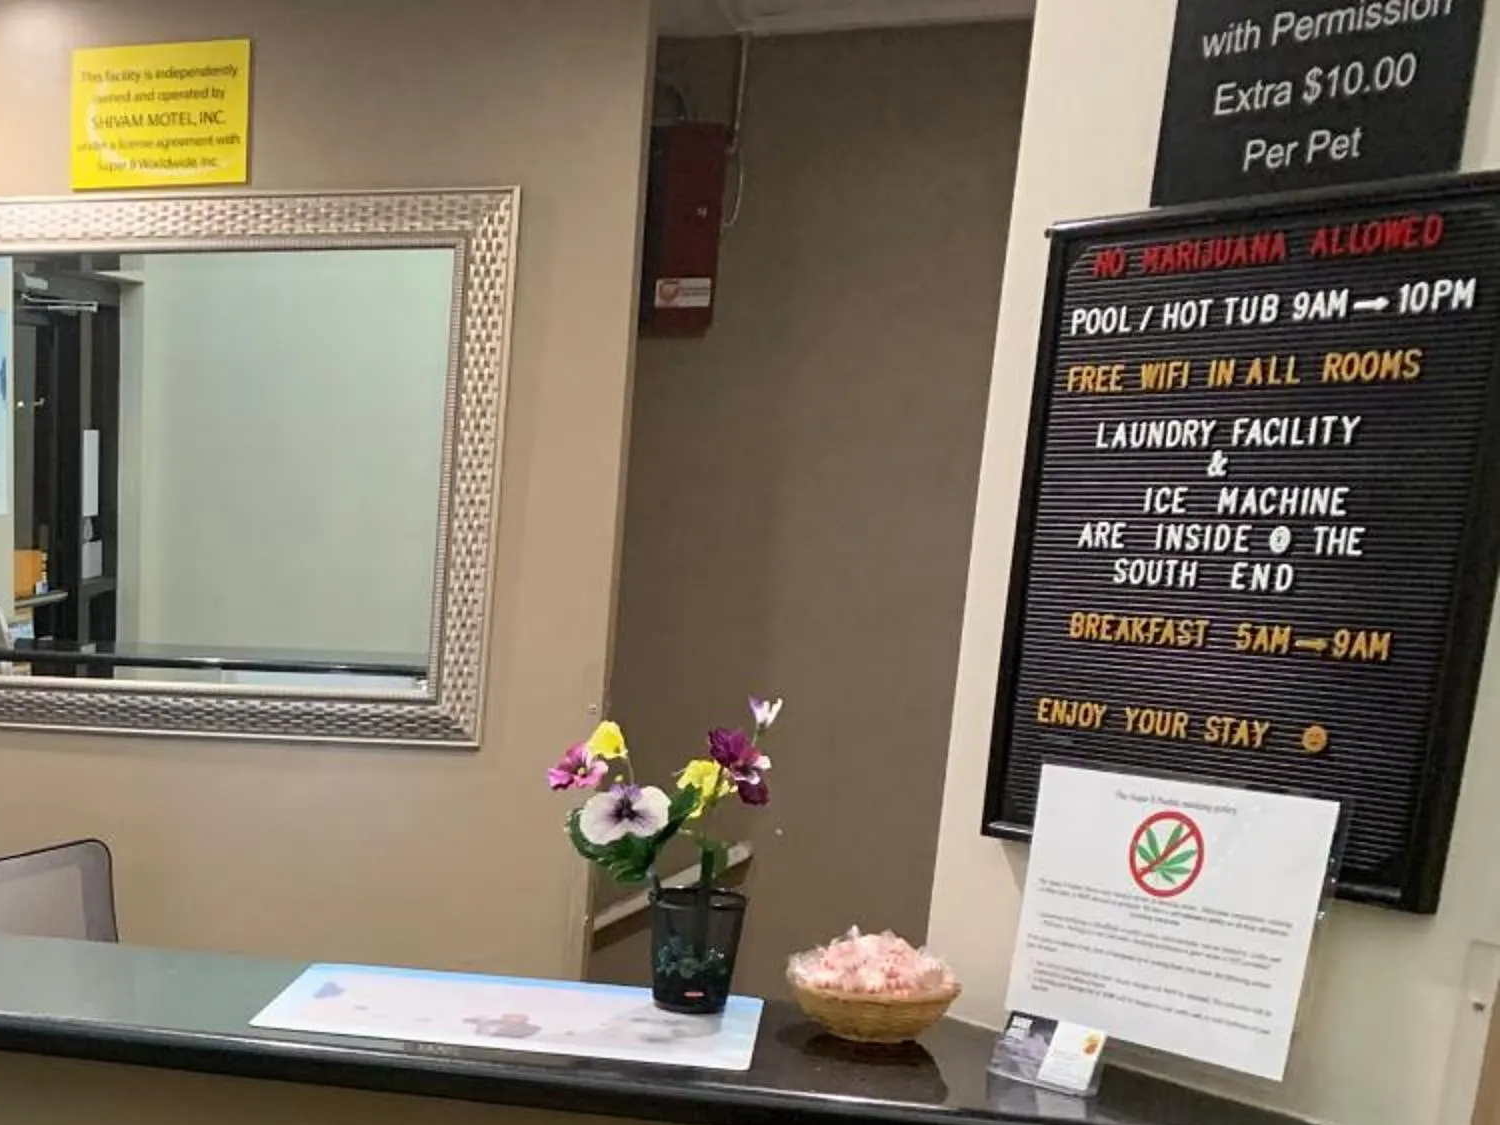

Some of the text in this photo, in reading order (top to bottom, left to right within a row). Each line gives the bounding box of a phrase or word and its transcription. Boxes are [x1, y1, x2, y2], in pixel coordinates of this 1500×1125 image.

[1203, 0, 1452, 59] with Permission
[1214, 52, 1417, 116] Extra $10.00
[1243, 126, 1364, 173] Per Pet
[1092, 214, 1444, 278] NO MARIJUANA ALLOWED
[1070, 306, 1131, 337] POOL
[1162, 298, 1214, 331] HOT
[1225, 292, 1279, 326] TUB
[1292, 289, 1349, 321] 9AM
[1399, 278, 1477, 314] 10PM
[1066, 348, 1423, 394] FREE WIFI IN ALL ROOMS
[1096, 415, 1362, 450] LAUNDRY FACILITY
[1206, 449, 1229, 478] &
[1142, 486, 1350, 518] ICE MACHINE
[1077, 521, 1127, 551] ARE
[1155, 522, 1252, 555] INSIDE
[1313, 525, 1366, 557] THE
[1113, 558, 1295, 593] SOUTH END
[1069, 611, 1393, 662] BREAKFAST 5AM 9AM
[1036, 697, 1271, 749] ENJOY YOUR STAY
